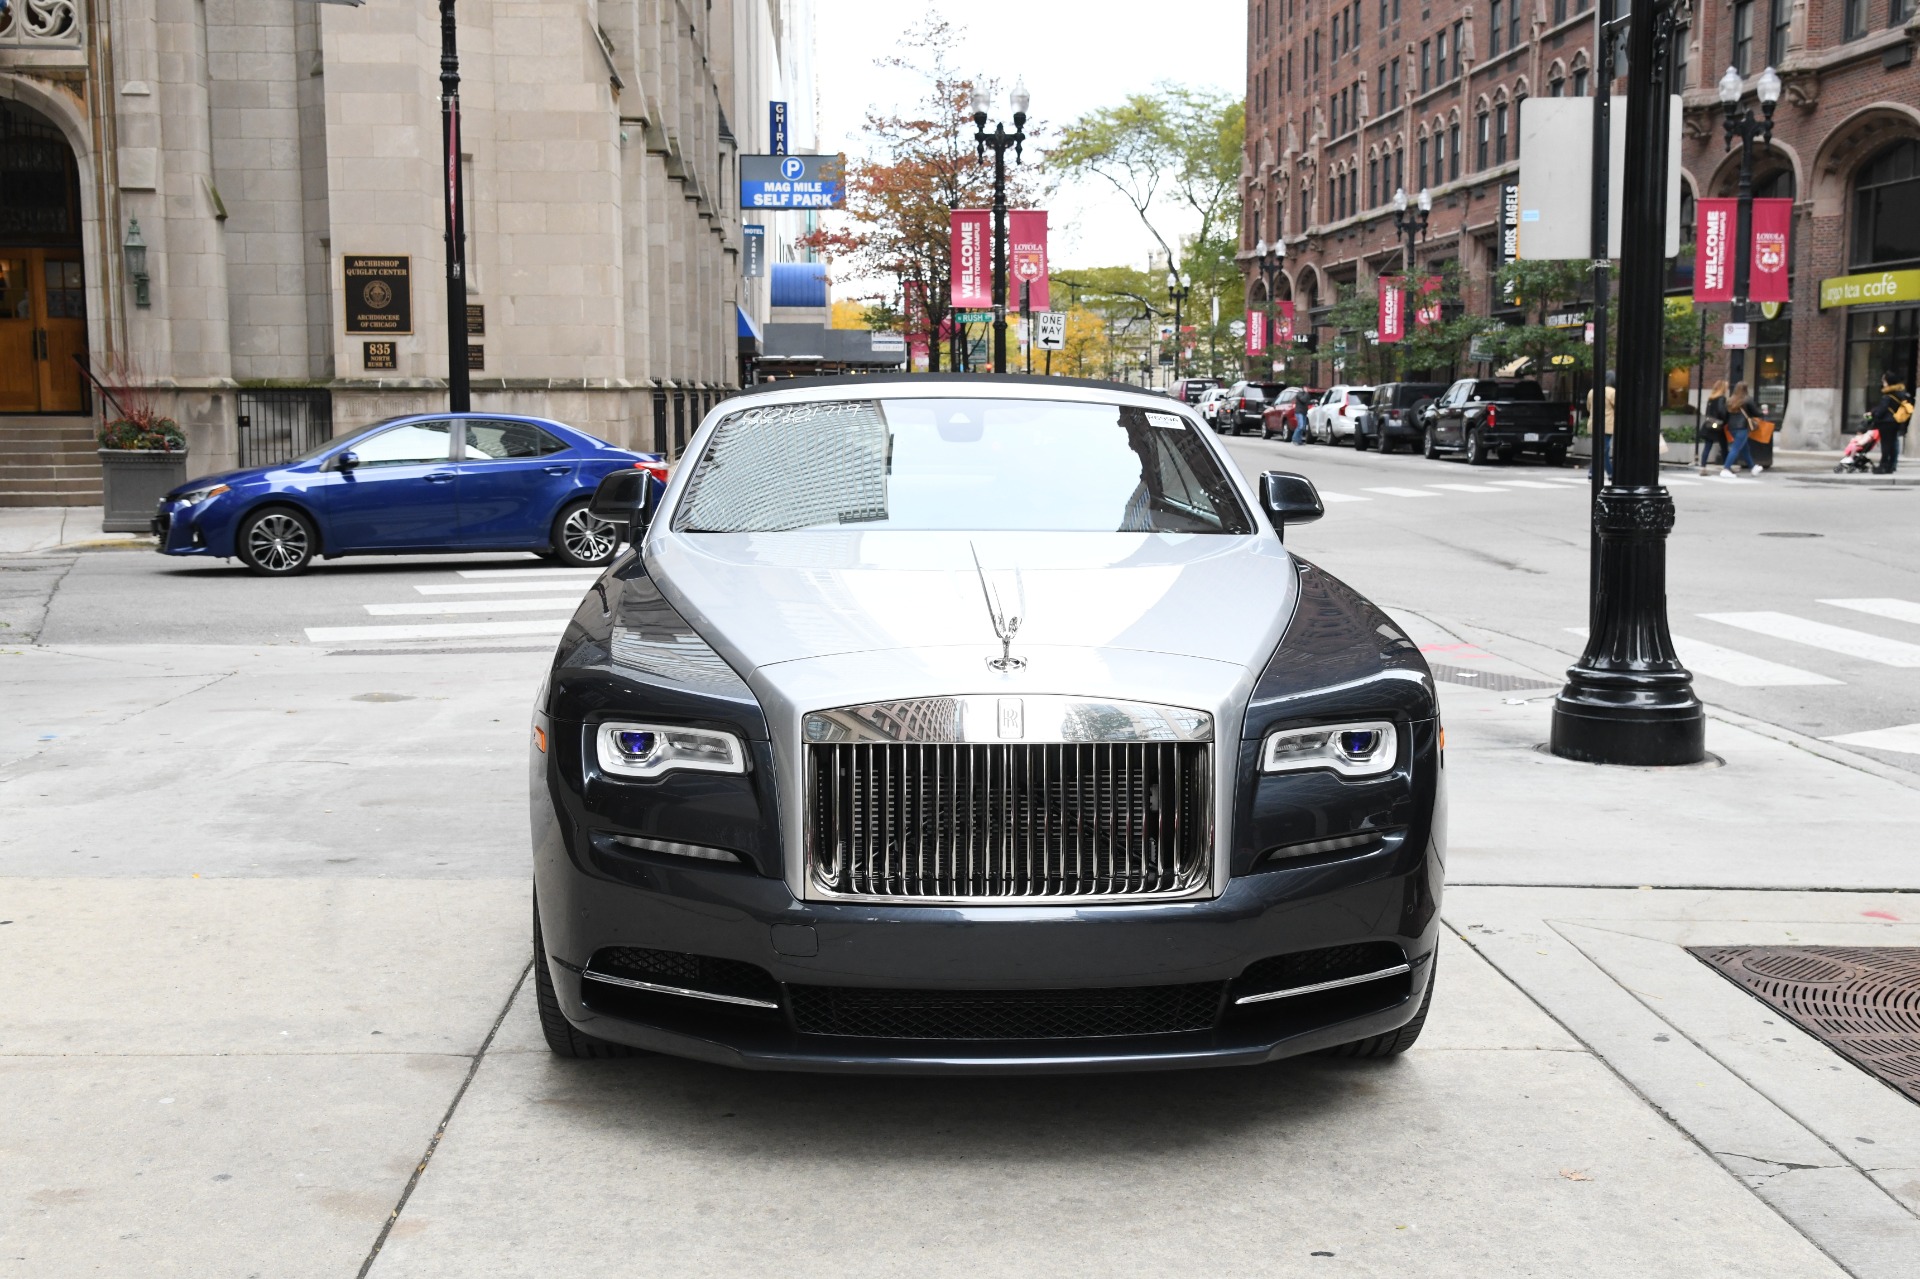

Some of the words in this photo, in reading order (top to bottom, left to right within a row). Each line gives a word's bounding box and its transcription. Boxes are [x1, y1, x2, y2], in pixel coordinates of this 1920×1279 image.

[786, 160, 800, 177] P
[764, 182, 791, 192] MAG
[793, 182, 822, 192] MILE
[753, 193, 789, 206] SELF
[792, 194, 833, 206] PARK
[1505, 185, 1519, 225] BAGELS
[1719, 210, 1727, 240] CAMPUS
[1014, 243, 1043, 251] LOYOLA
[1704, 210, 1719, 290] WELCOME
[353, 260, 400, 268] ARCHBISHOP
[961, 222, 974, 299] WELCOME
[346, 268, 378, 276] QUIGLEY
[1844, 283, 1860, 298] tea
[1863, 273, 1898, 297] café
[963, 314, 983, 322] RUSH
[1042, 315, 1062, 325] ONE
[1041, 326, 1062, 335] WAY
[1251, 311, 1259, 350] WELCOME
[369, 343, 391, 355] 835
